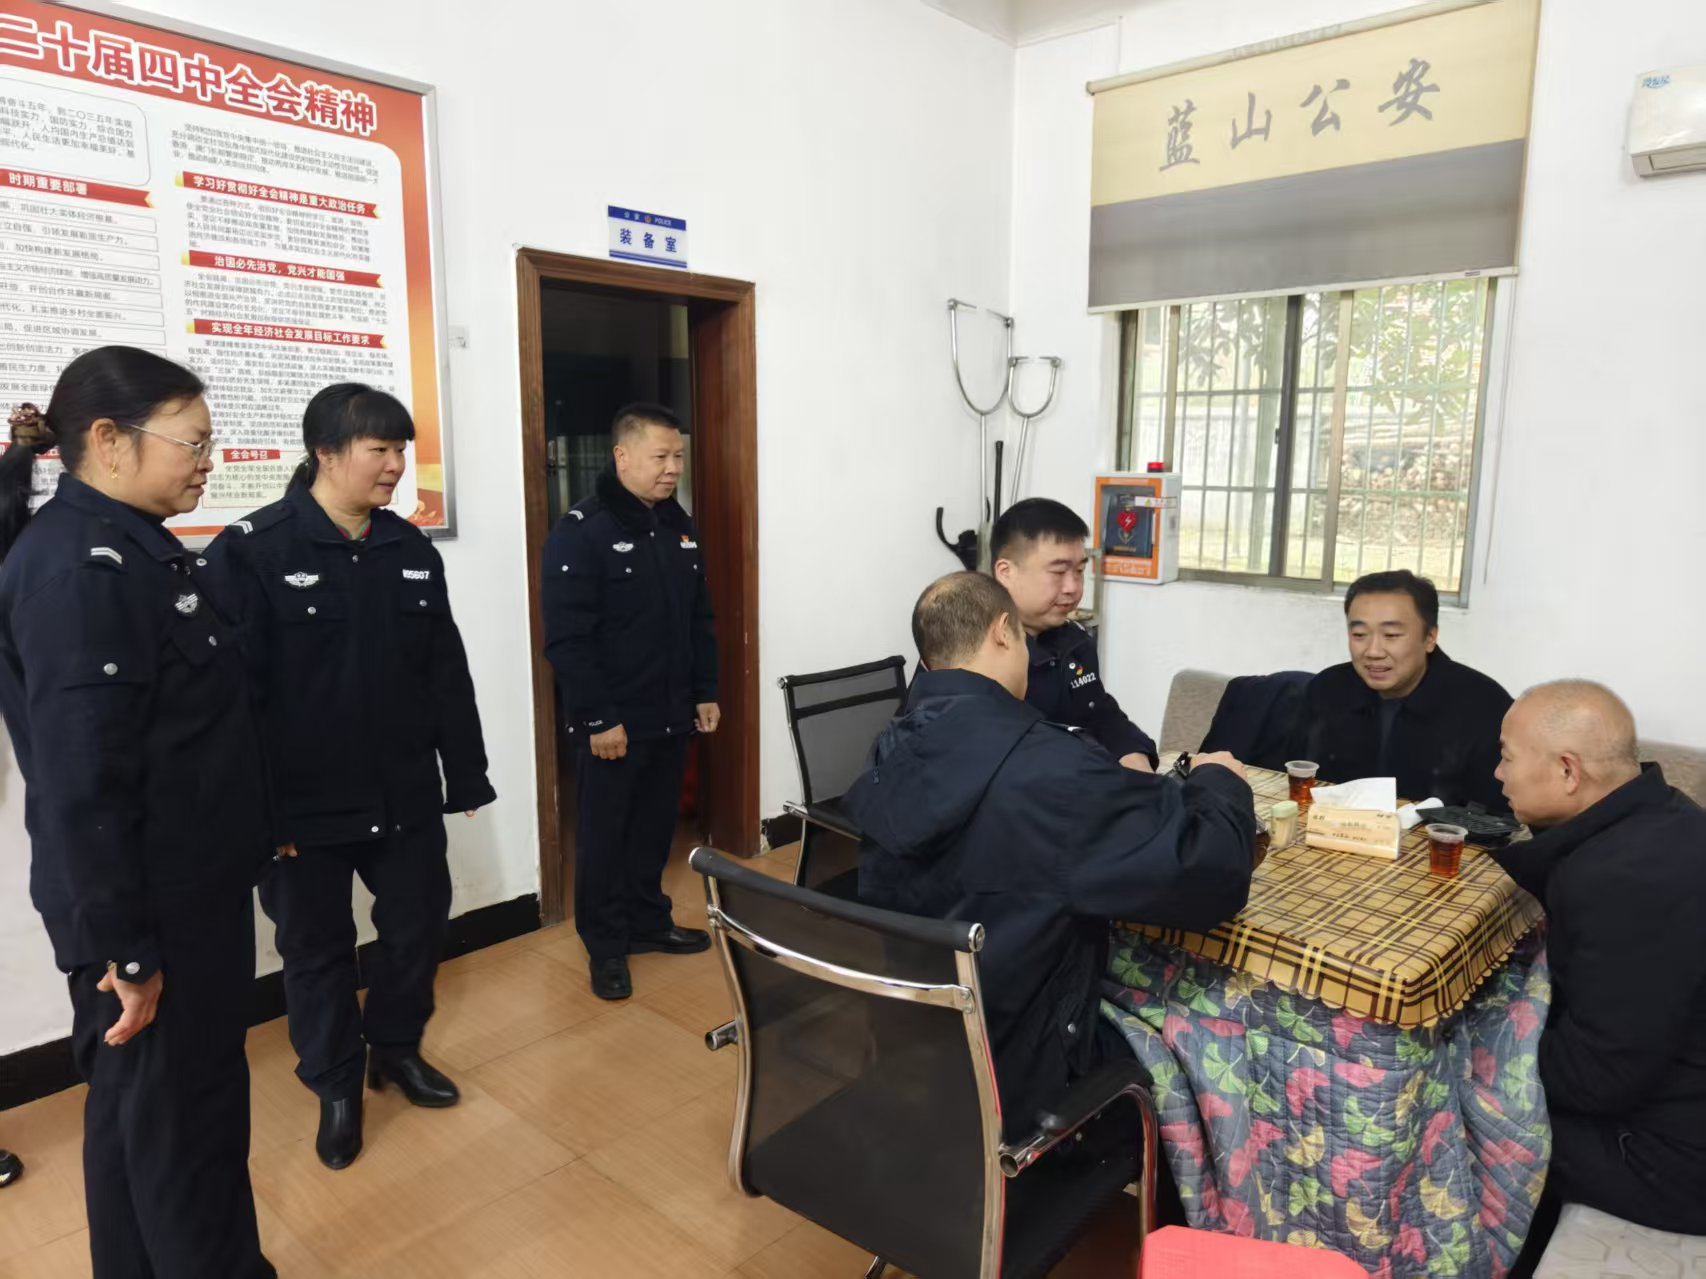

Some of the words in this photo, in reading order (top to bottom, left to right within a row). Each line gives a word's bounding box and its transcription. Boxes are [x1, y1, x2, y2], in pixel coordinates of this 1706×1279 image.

[0, 13, 378, 136] 二十届四中全会精神
[8, 171, 88, 196] 时期重要部署
[193, 175, 367, 214] 学习好贯彻好全会精神是重大政治任务
[619, 228, 678, 253] 装备室
[214, 251, 345, 281] 治国必先治党，党兴才能国强
[211, 322, 371, 345] 实现全年经济社会发展目标工作要求
[230, 449, 269, 460] 全会号召
